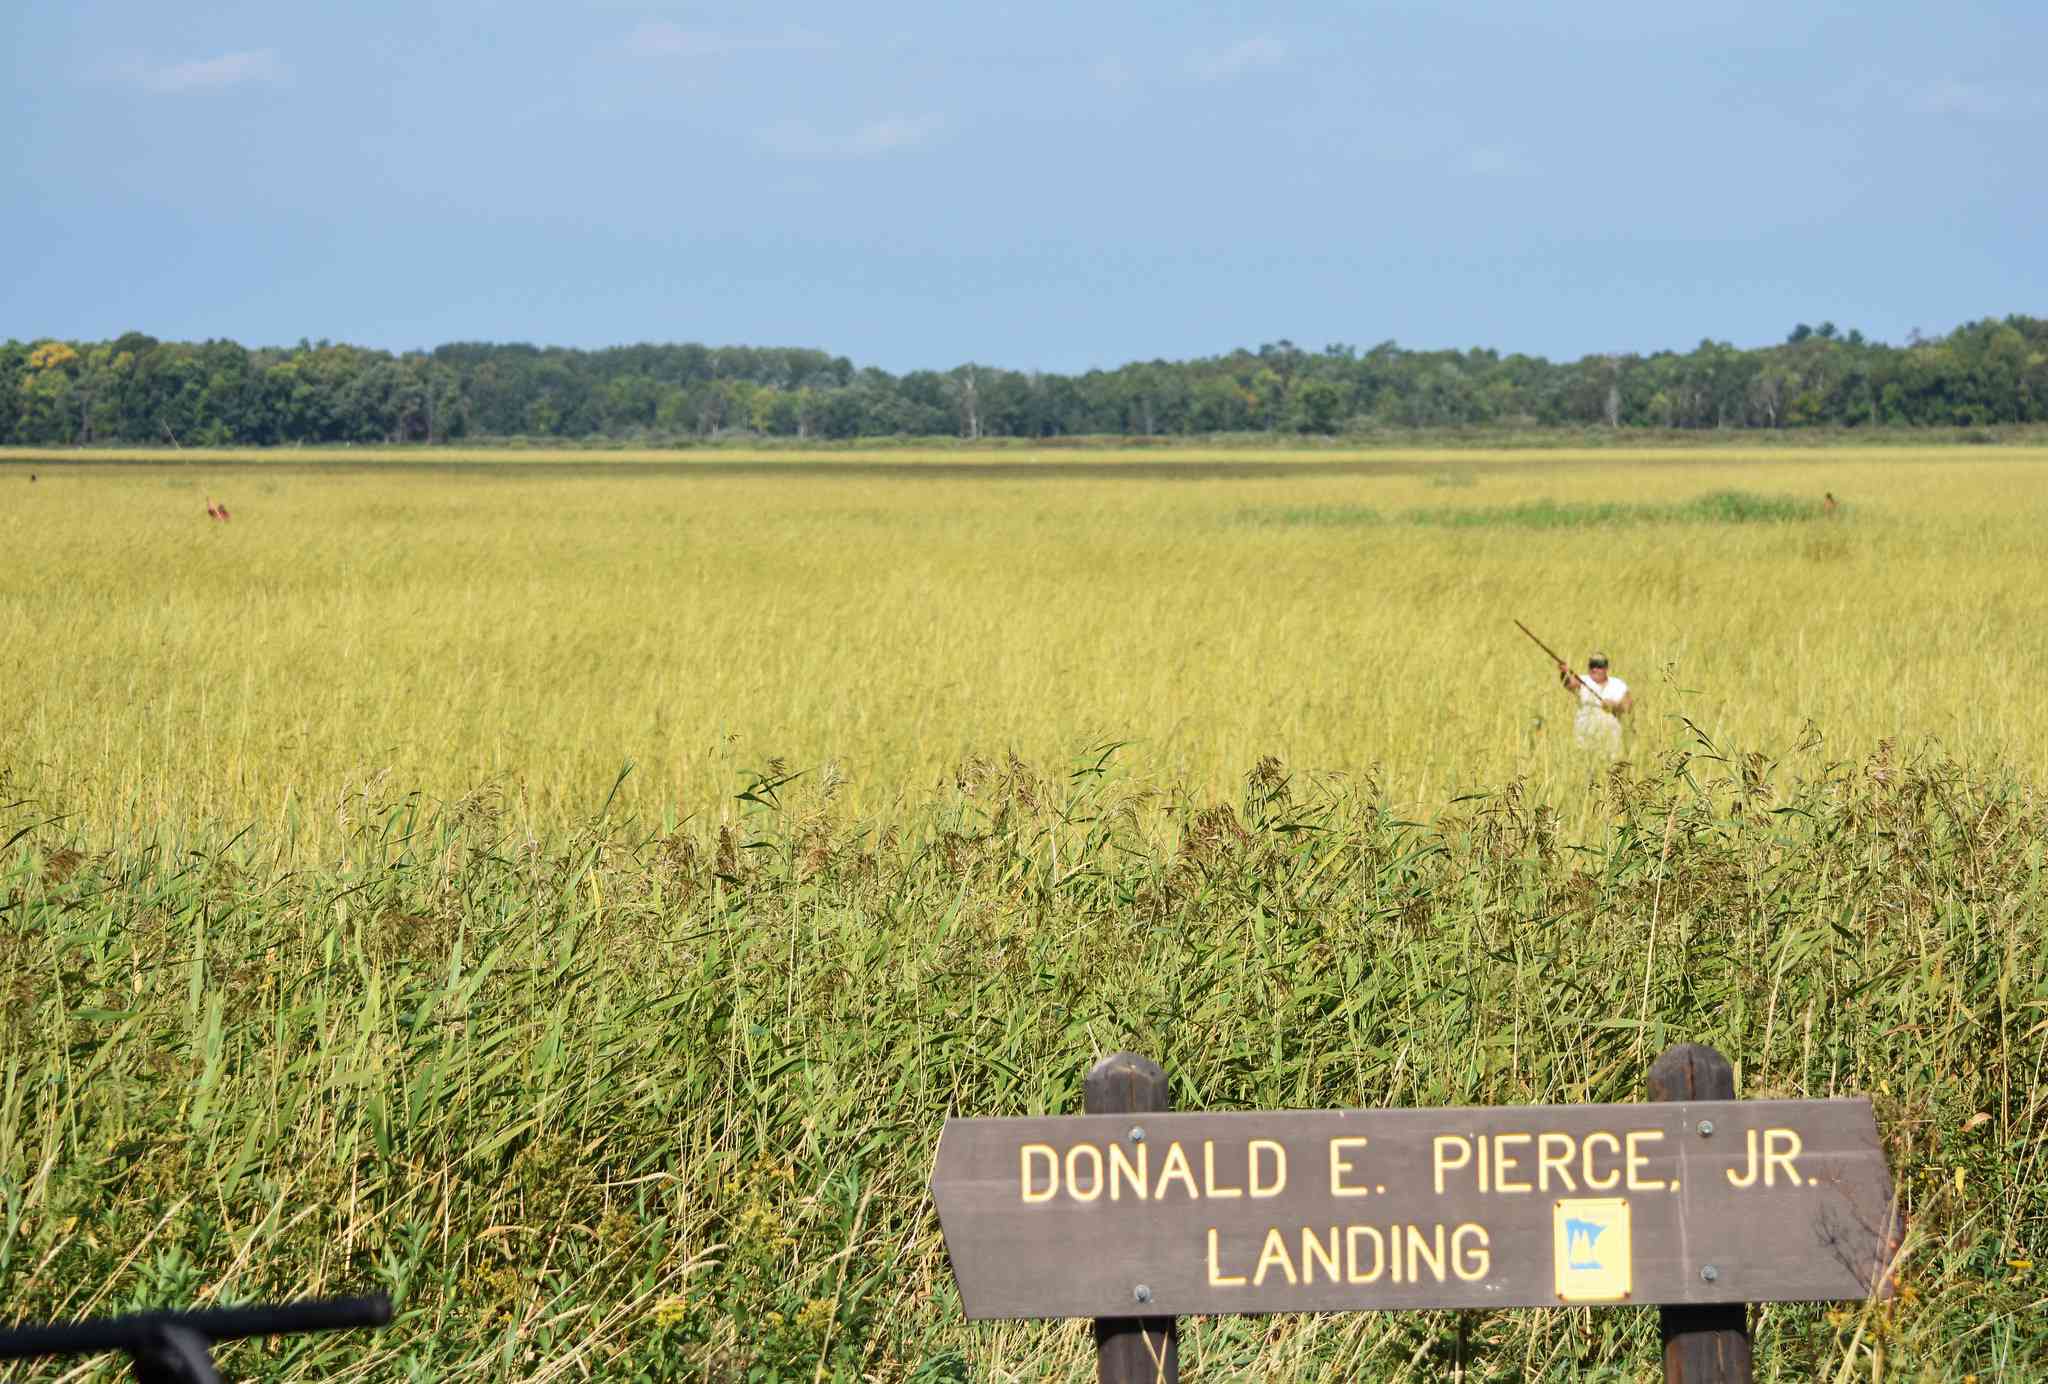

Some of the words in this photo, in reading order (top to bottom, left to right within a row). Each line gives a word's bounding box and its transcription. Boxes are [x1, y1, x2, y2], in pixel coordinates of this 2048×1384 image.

[1020, 1140, 1287, 1204] DONALD
[1329, 1136, 1386, 1197] E.
[1433, 1130, 1681, 1195] PIERCE,
[1726, 1128, 1819, 1188] JR.
[1207, 1222, 1490, 1288] LANDING
